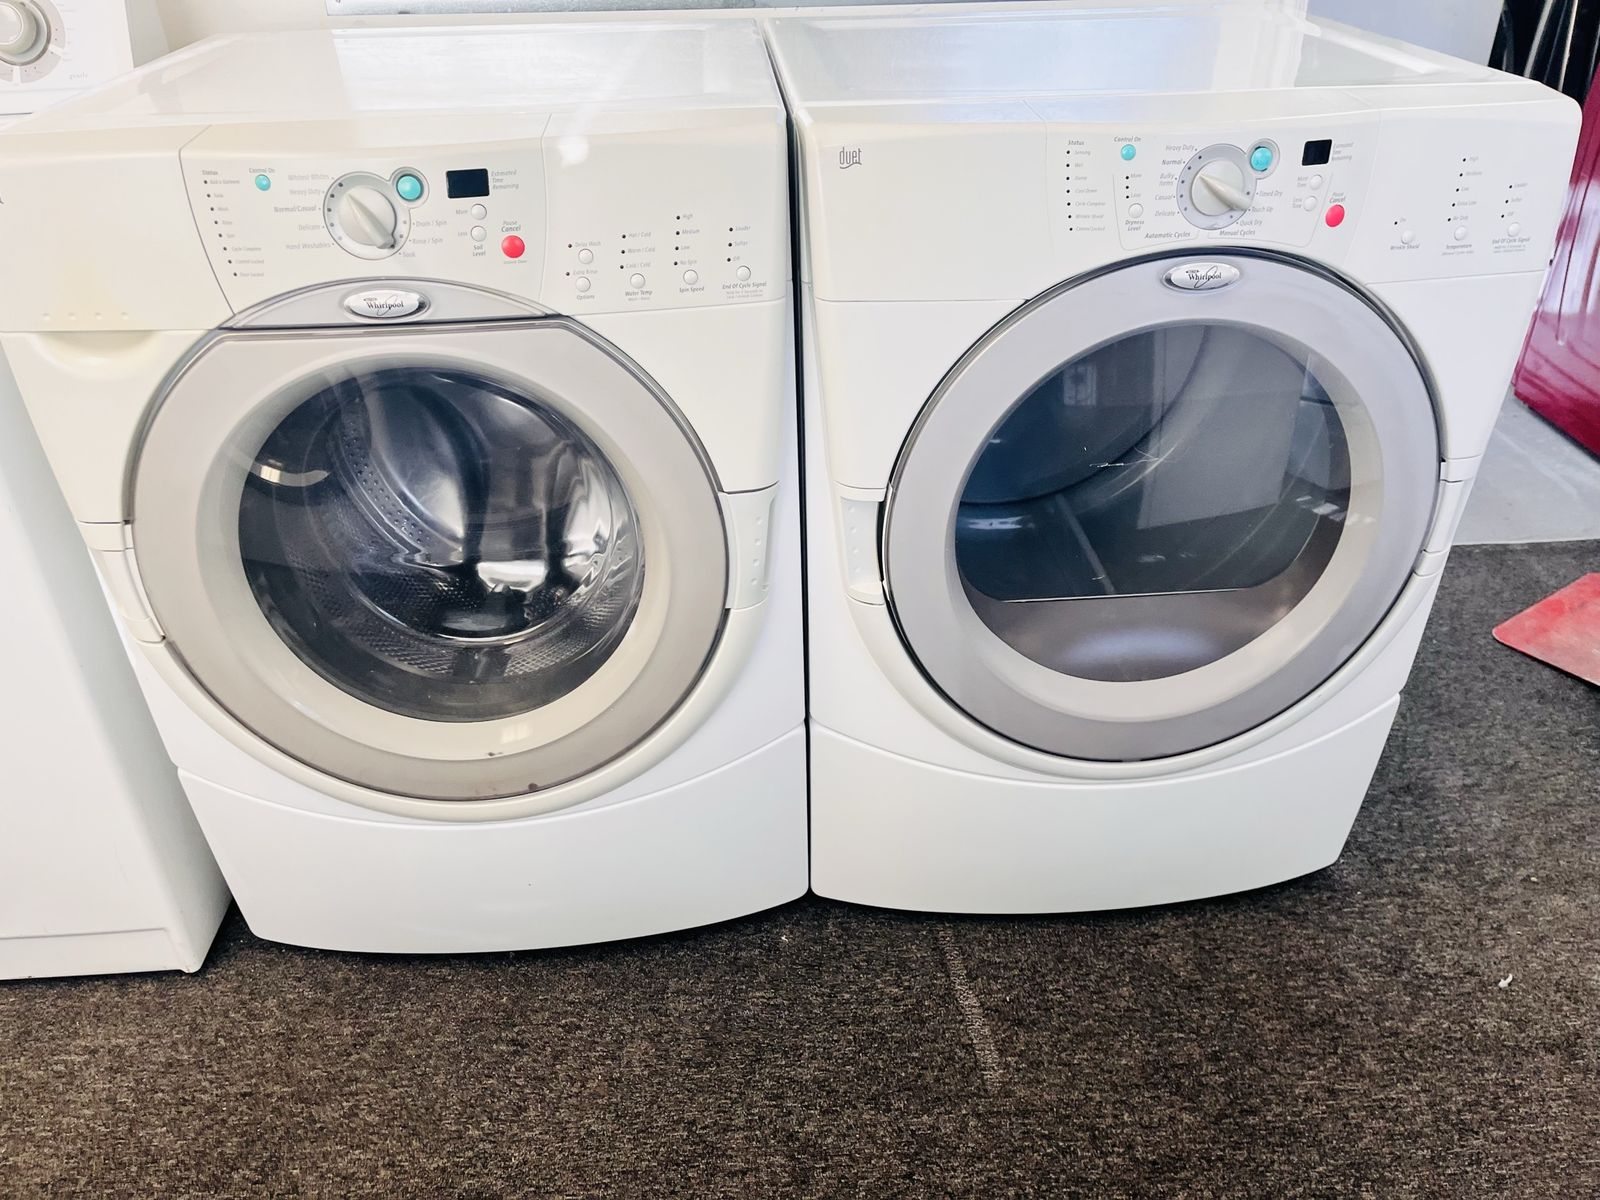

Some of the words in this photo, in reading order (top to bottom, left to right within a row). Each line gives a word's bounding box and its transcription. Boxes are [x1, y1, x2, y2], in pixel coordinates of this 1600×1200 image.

[840, 146, 862, 166] duet
[1188, 272, 1222, 282] Whirlpool
[366, 300, 404, 310] Whirlpool
